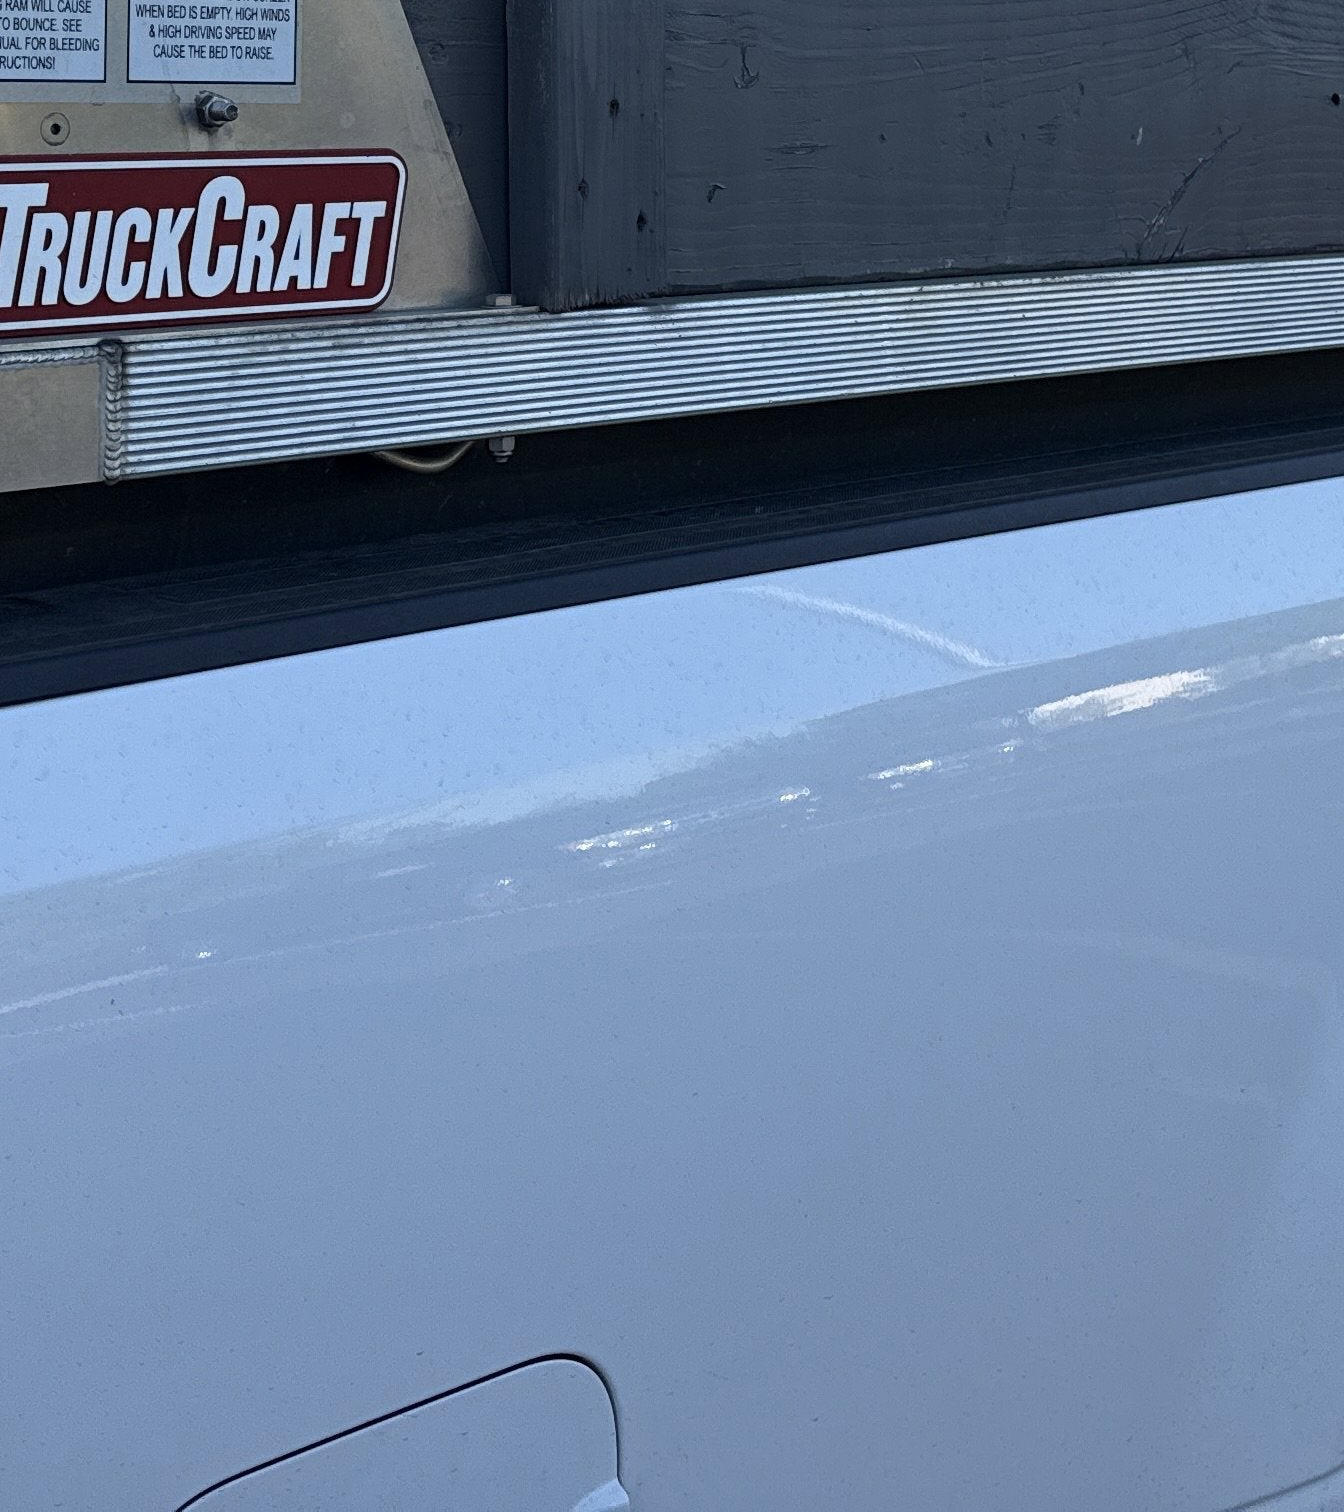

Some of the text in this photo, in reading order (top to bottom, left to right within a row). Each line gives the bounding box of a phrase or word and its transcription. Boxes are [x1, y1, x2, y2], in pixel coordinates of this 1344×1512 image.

[31, 0, 54, 13] WILL
[57, 0, 92, 14] CAUSE
[135, 4, 165, 19] WHEN
[167, 5, 186, 19] BED
[189, 5, 198, 19] IS
[235, 7, 258, 21] HIGH
[260, 8, 290, 22] WINDS
[62, 18, 82, 32] SEE
[149, 24, 277, 41] & HIGH DRIVING SPEED MAY
[25, 36, 46, 50] FOR
[49, 37, 100, 52] BLEEDING
[153, 44, 186, 59] CAUSE
[188, 45, 206, 59] THE
[208, 45, 228, 59] BED
[230, 46, 243, 59] TO
